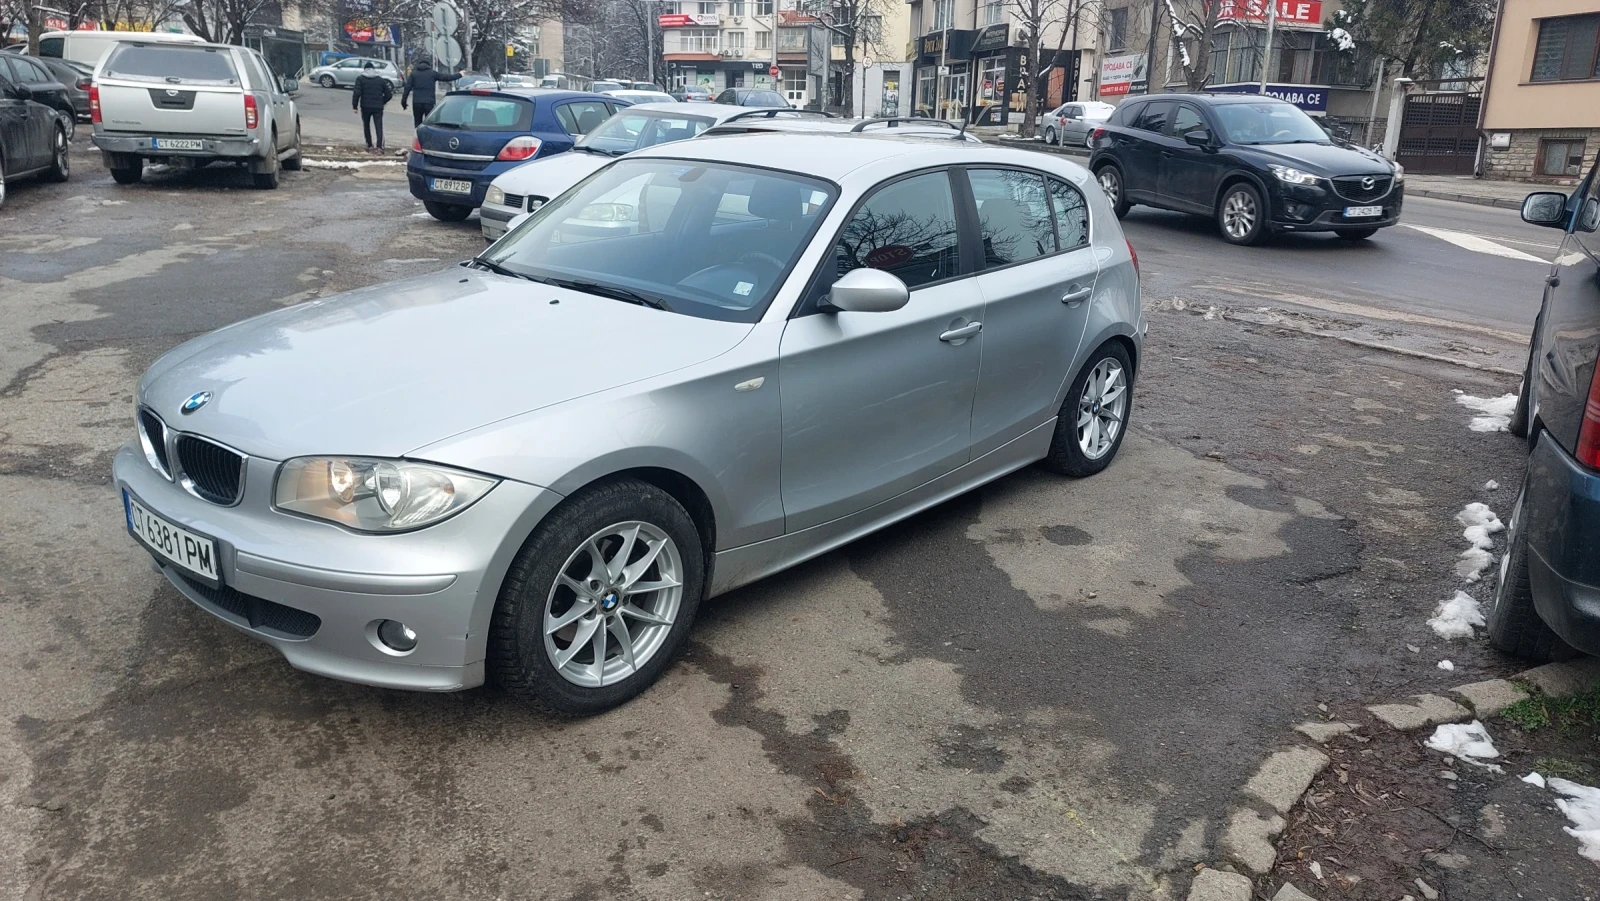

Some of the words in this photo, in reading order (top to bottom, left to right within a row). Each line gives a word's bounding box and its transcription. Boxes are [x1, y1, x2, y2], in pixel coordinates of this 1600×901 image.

[1246, 0, 1311, 20] SALE
[1258, 91, 1304, 104] ОДАВА
[1307, 93, 1321, 105] СЕ
[170, 140, 190, 148] 6222
[131, 500, 145, 537] CT
[147, 515, 182, 561] 6381
[184, 535, 213, 574] PM
